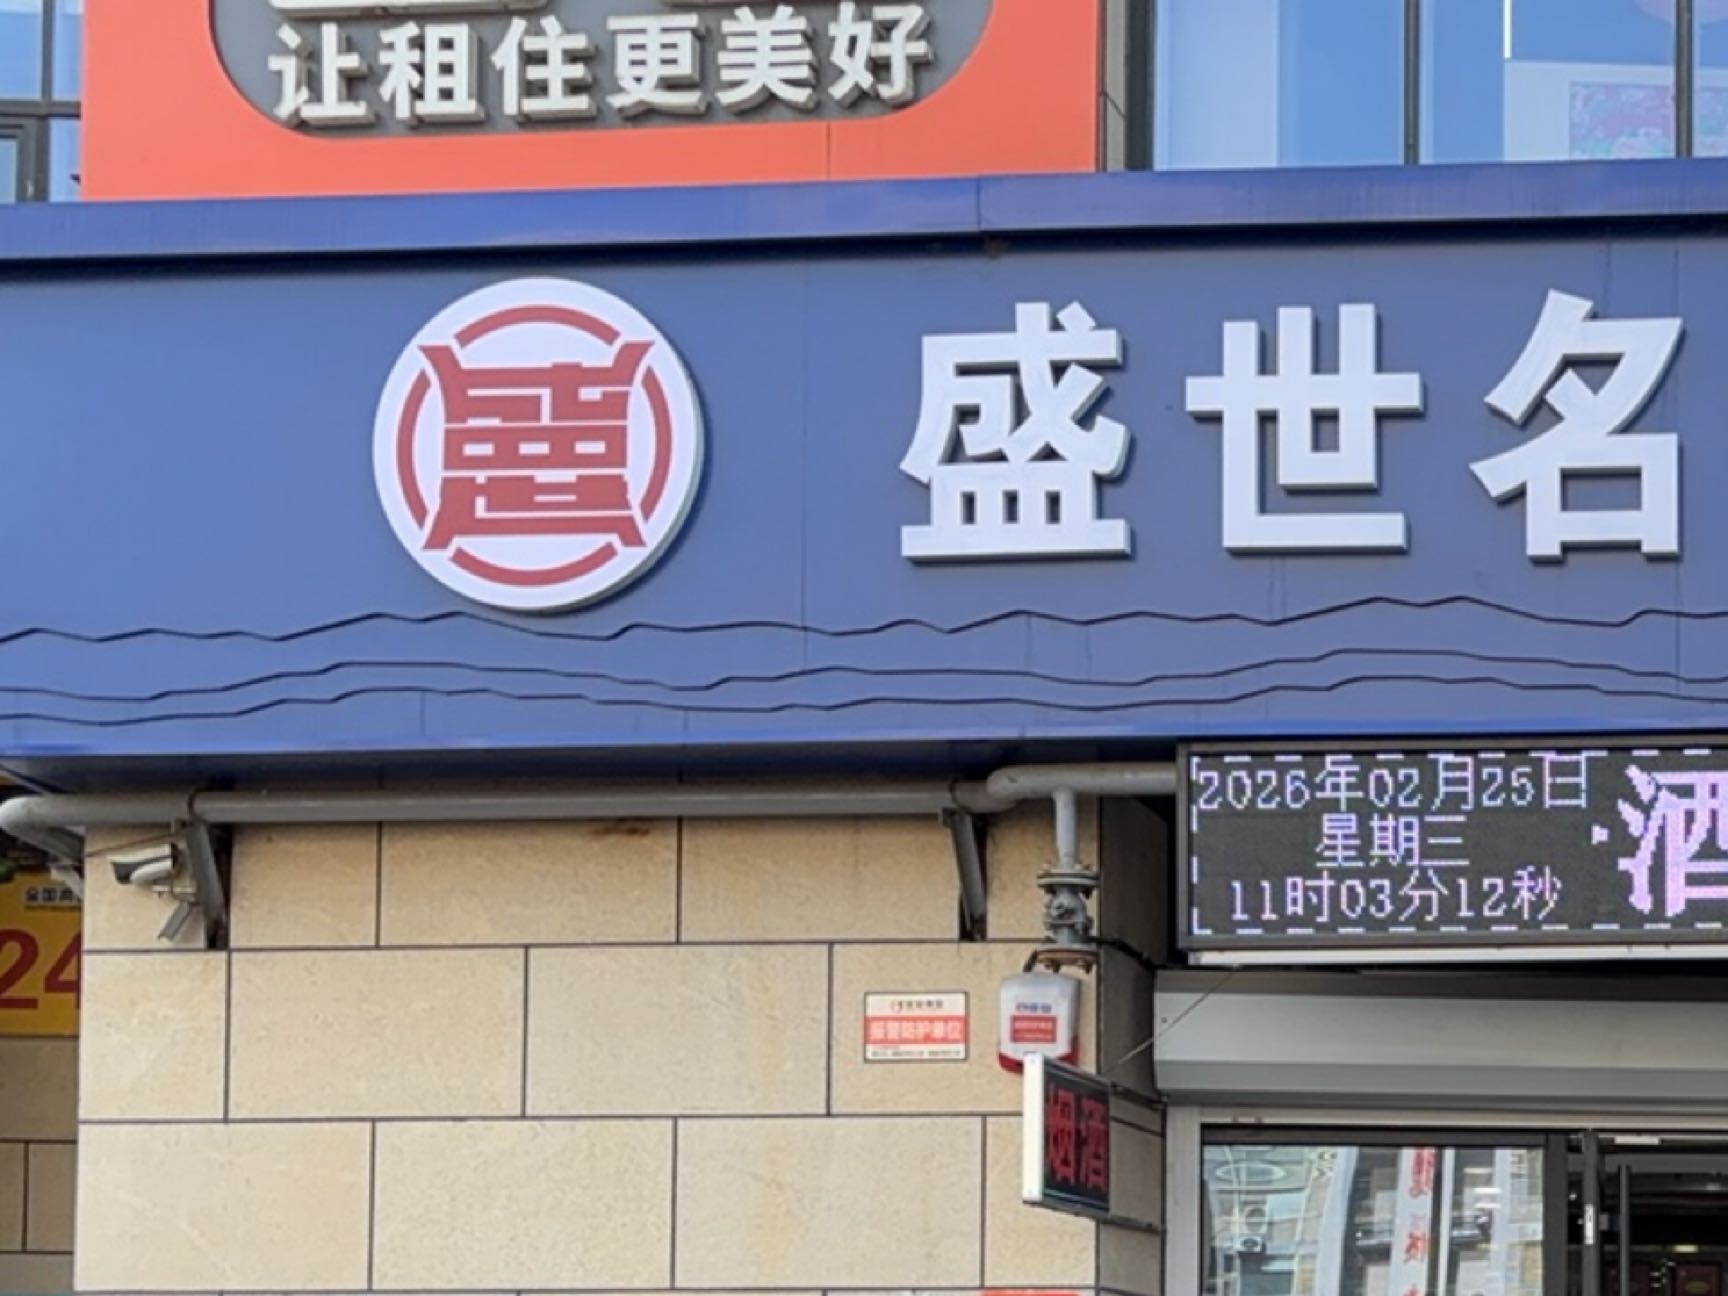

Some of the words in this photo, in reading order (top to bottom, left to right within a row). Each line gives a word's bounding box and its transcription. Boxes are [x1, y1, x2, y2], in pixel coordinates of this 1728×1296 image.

[267, 2, 936, 130] 让租住更美好
[1198, 754, 1588, 812] 2026年02月25日
[1315, 813, 1471, 868] 星期三
[1230, 865, 1563, 923] 11时03分12秒
